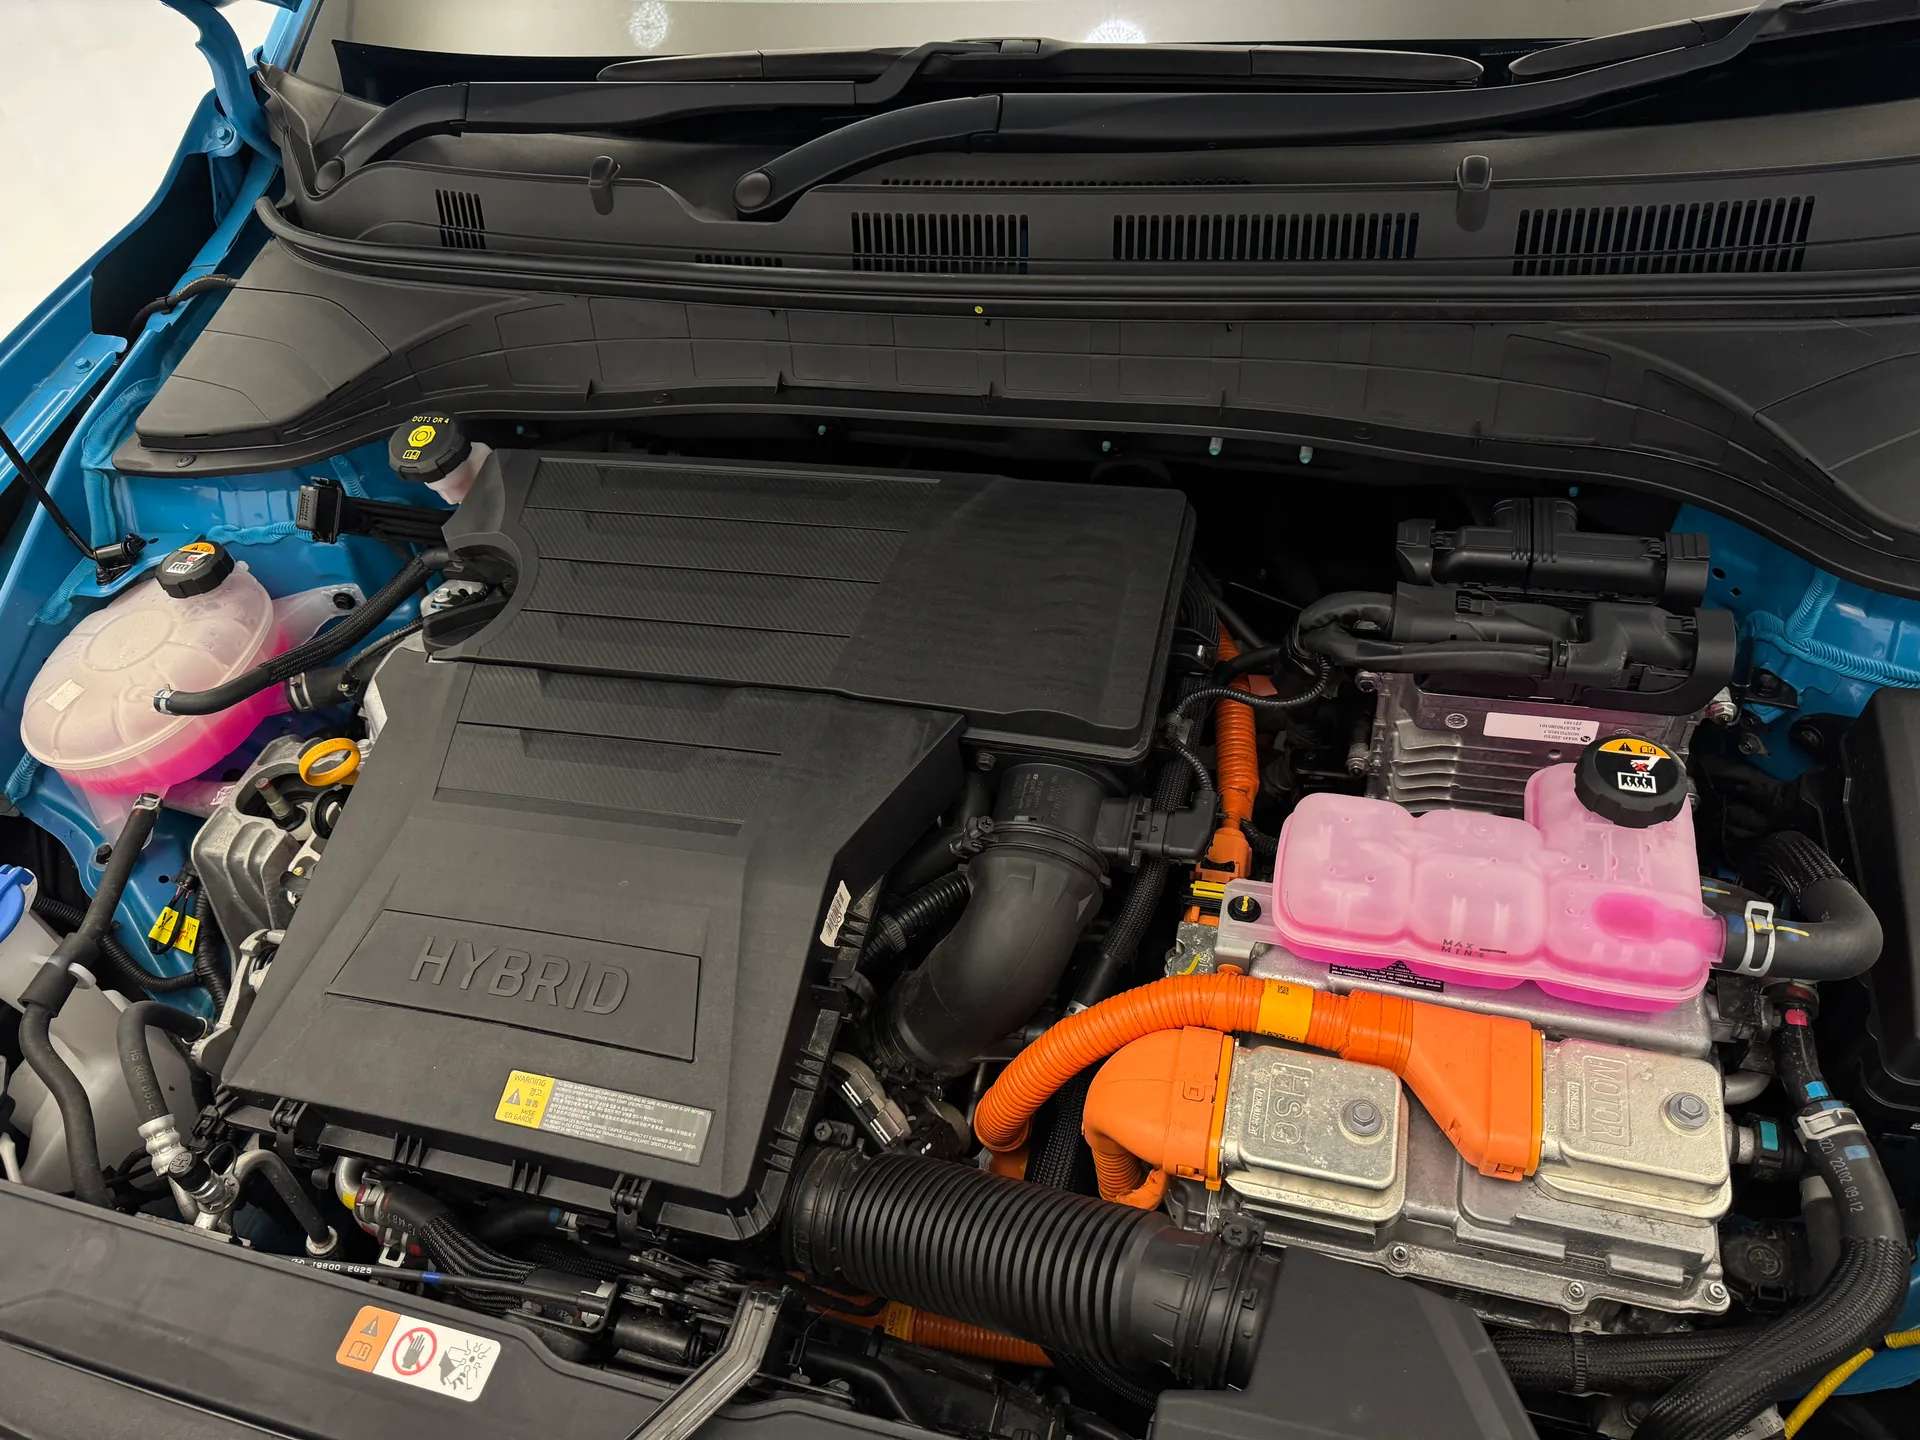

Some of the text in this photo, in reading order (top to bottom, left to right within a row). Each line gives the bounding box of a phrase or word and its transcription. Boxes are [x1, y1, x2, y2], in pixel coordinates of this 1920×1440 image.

[1440, 946, 1472, 956] MIN
[1443, 939, 1473, 949] MAX
[408, 935, 629, 1016] HYBRID
[514, 1073, 546, 1087] WARNING
[1591, 1064, 1624, 1138] MOTOR
[1272, 1072, 1310, 1144] HSG
